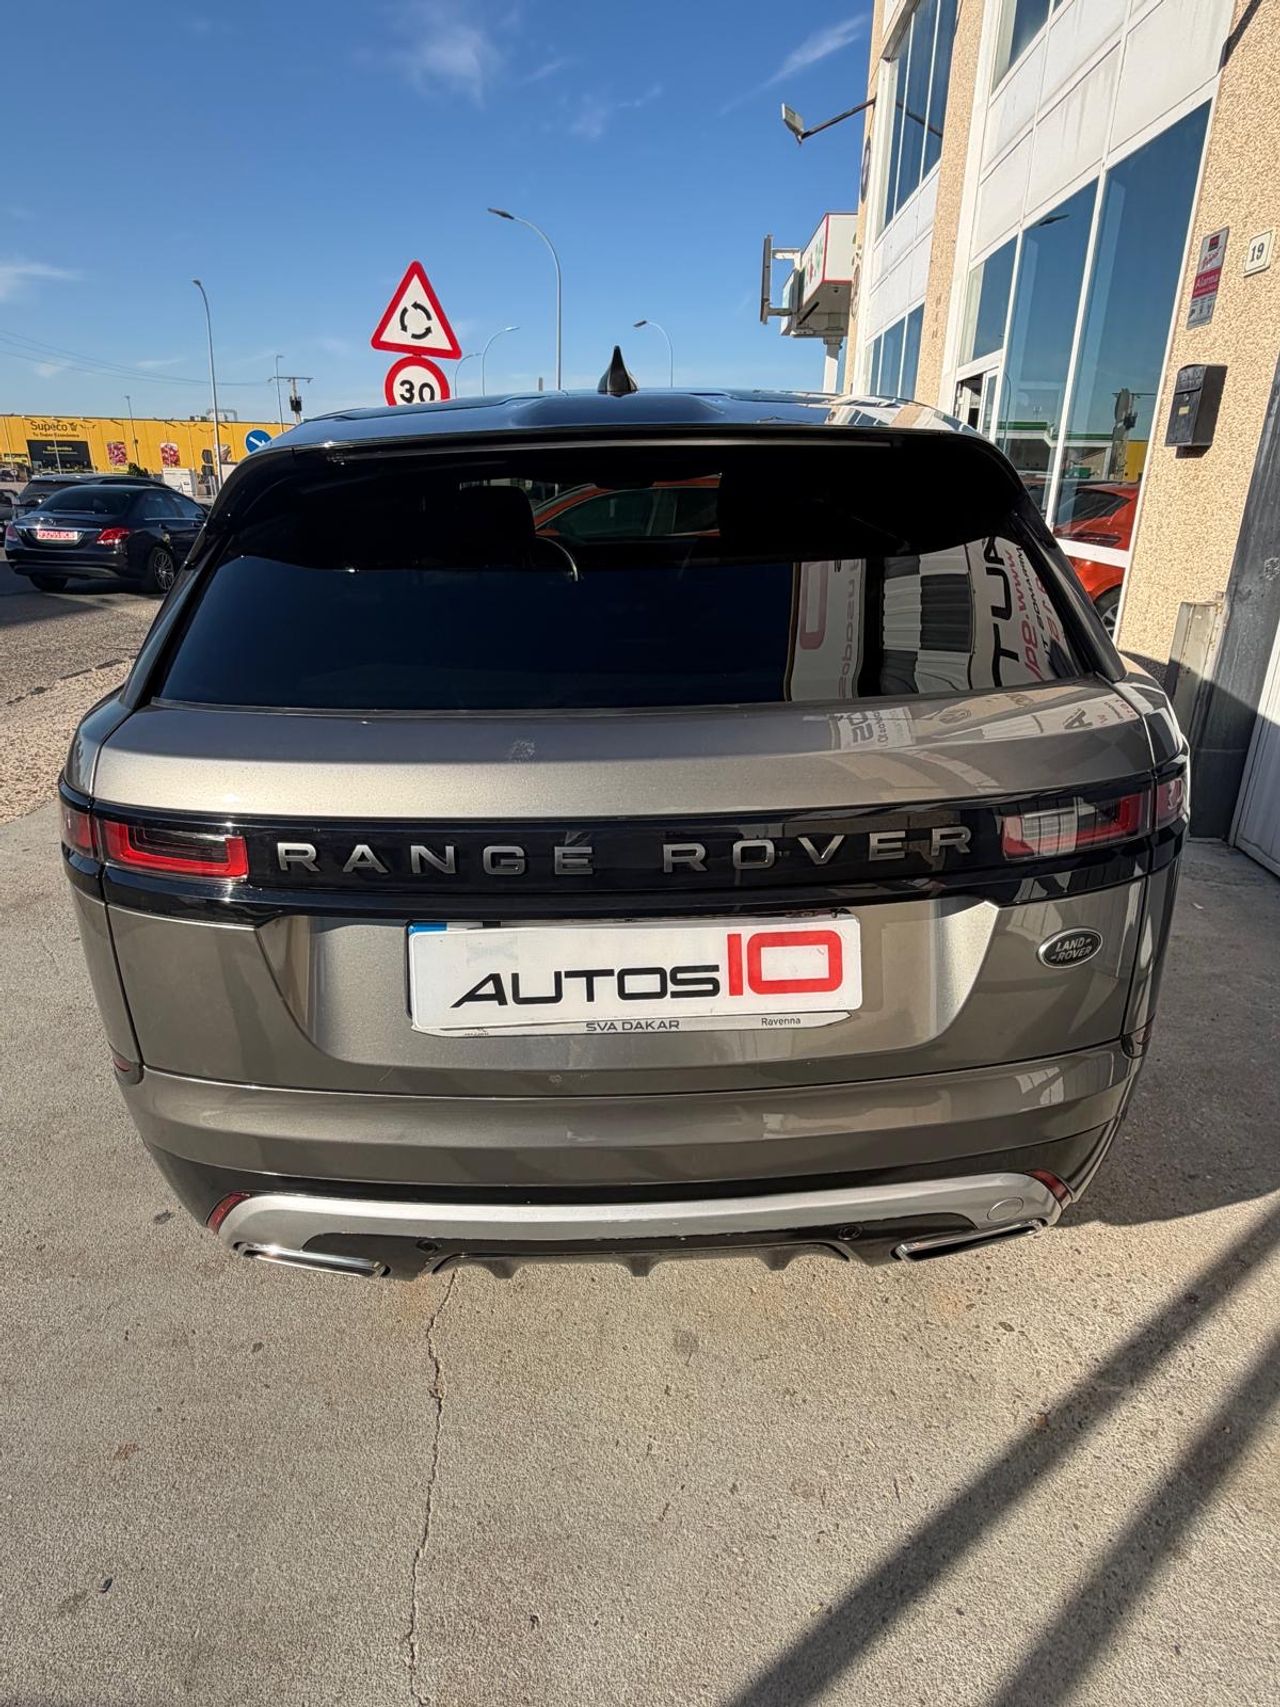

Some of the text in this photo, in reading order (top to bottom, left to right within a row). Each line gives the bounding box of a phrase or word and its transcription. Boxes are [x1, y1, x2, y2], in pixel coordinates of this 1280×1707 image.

[1250, 242, 1265, 262] 19
[399, 379, 436, 404] 30
[30, 421, 68, 432] Supeco
[277, 826, 972, 876] RANGE ROVER
[1055, 937, 1085, 953] LAND
[1056, 945, 1093, 962] ROVER
[586, 1020, 680, 1032] SVA DAKAR
[761, 1017, 801, 1026] Ravenna
